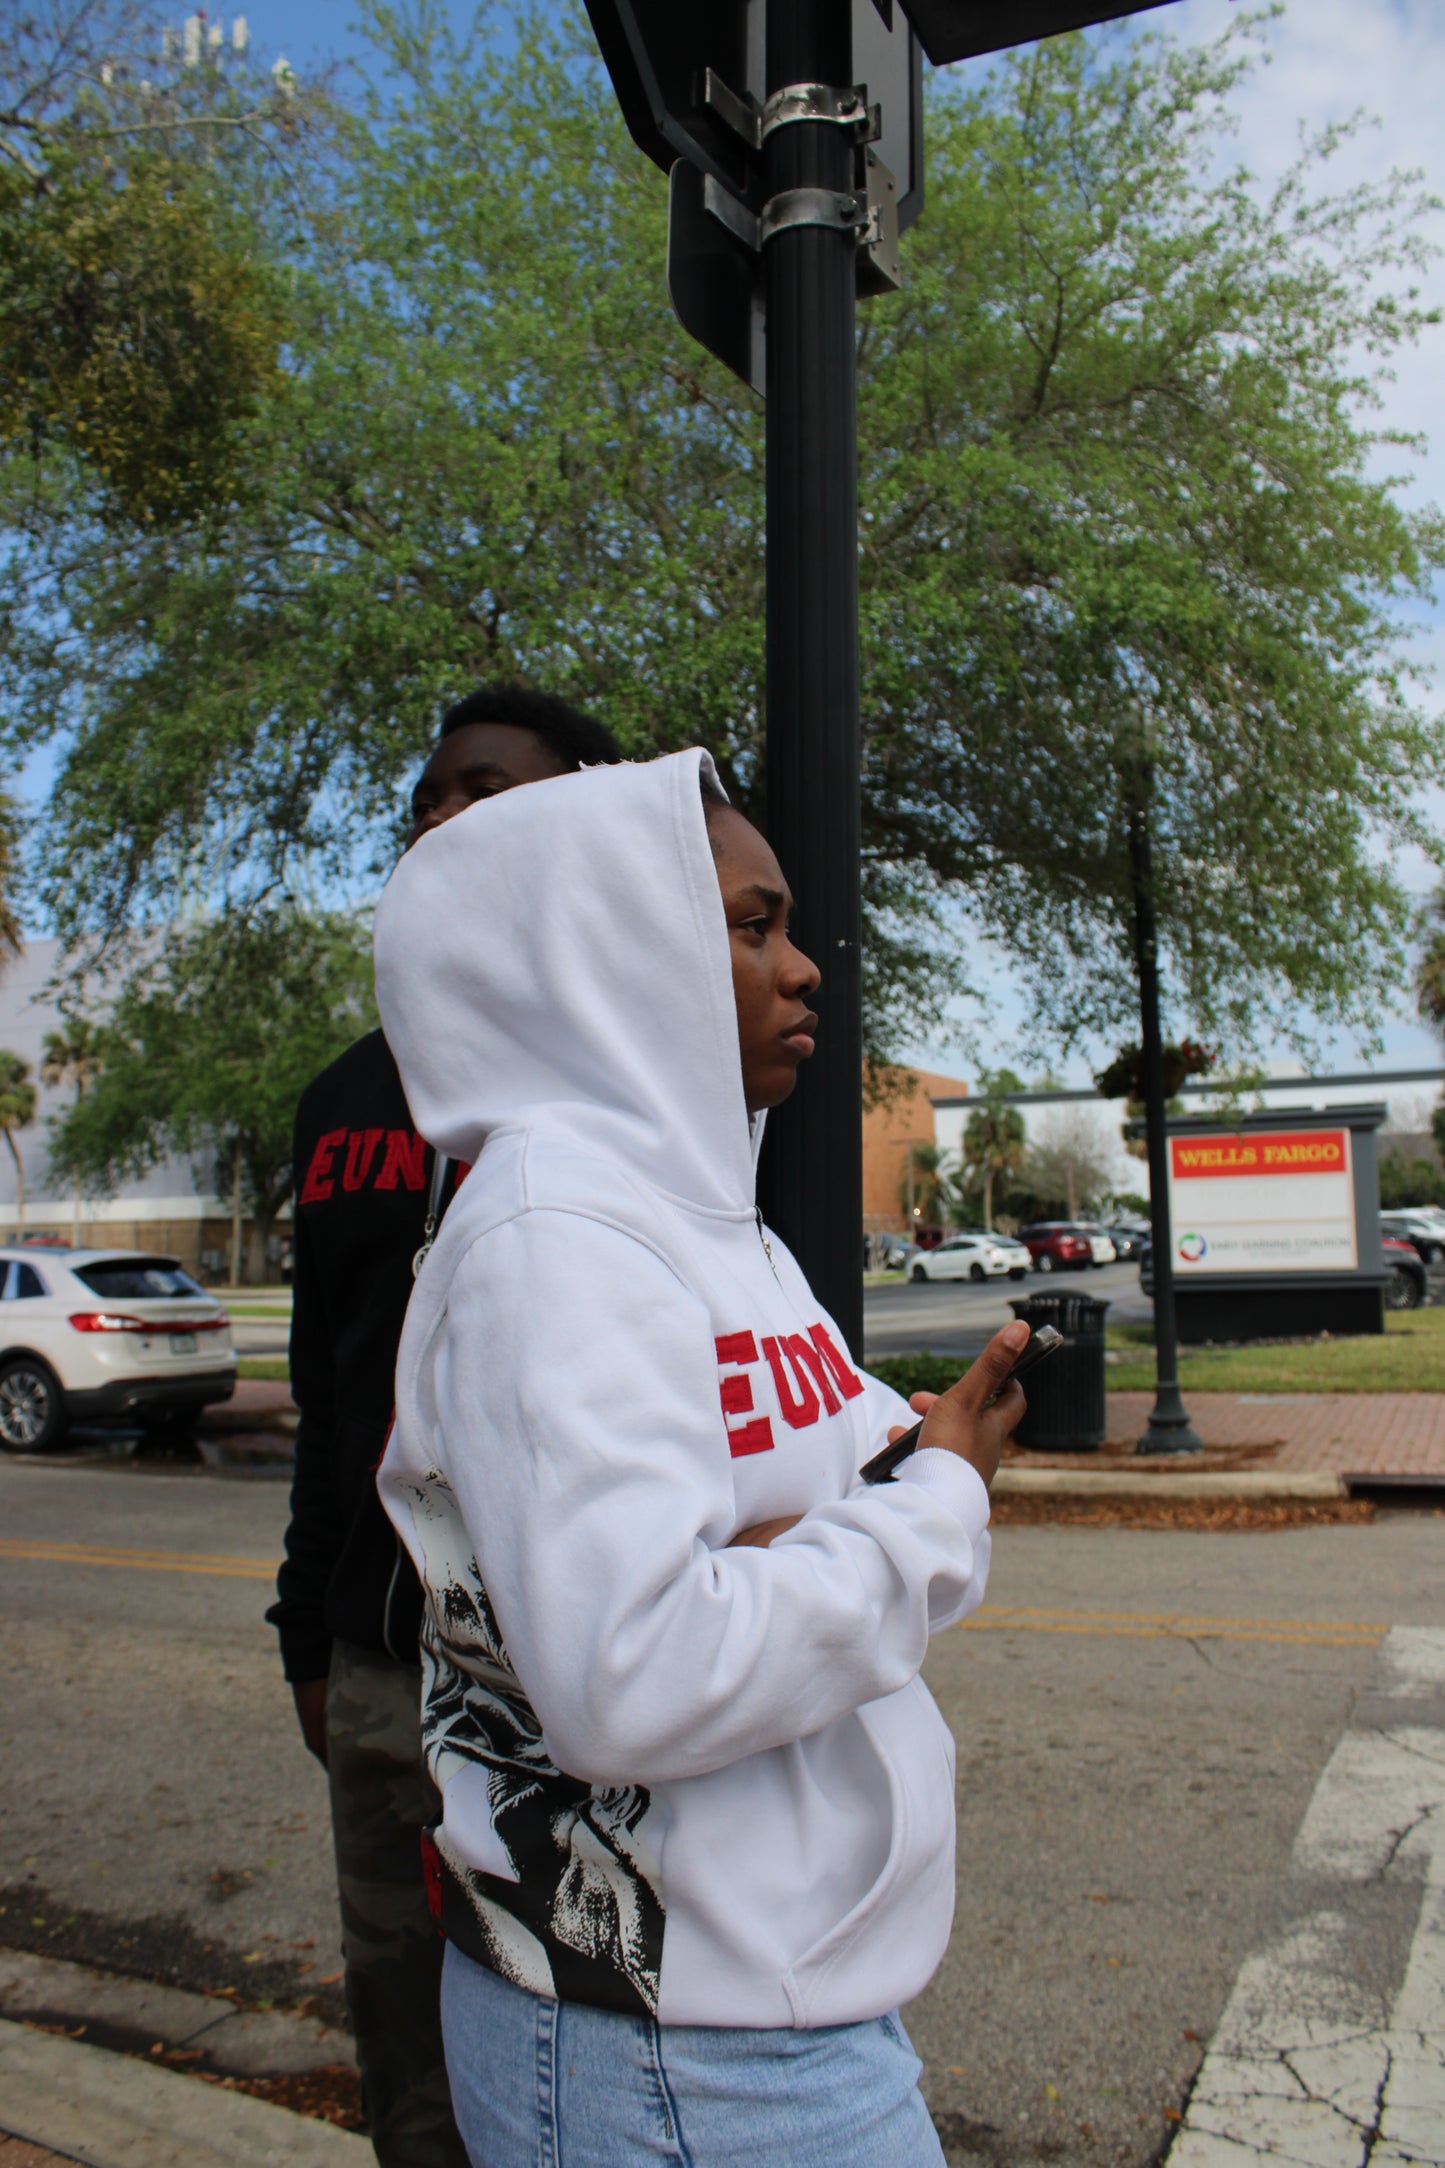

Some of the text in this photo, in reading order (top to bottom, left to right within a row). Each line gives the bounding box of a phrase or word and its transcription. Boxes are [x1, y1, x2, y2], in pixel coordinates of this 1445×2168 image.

[299, 1126, 472, 1205] EUN
[1178, 1144, 1339, 1167] WELLS FARGO
